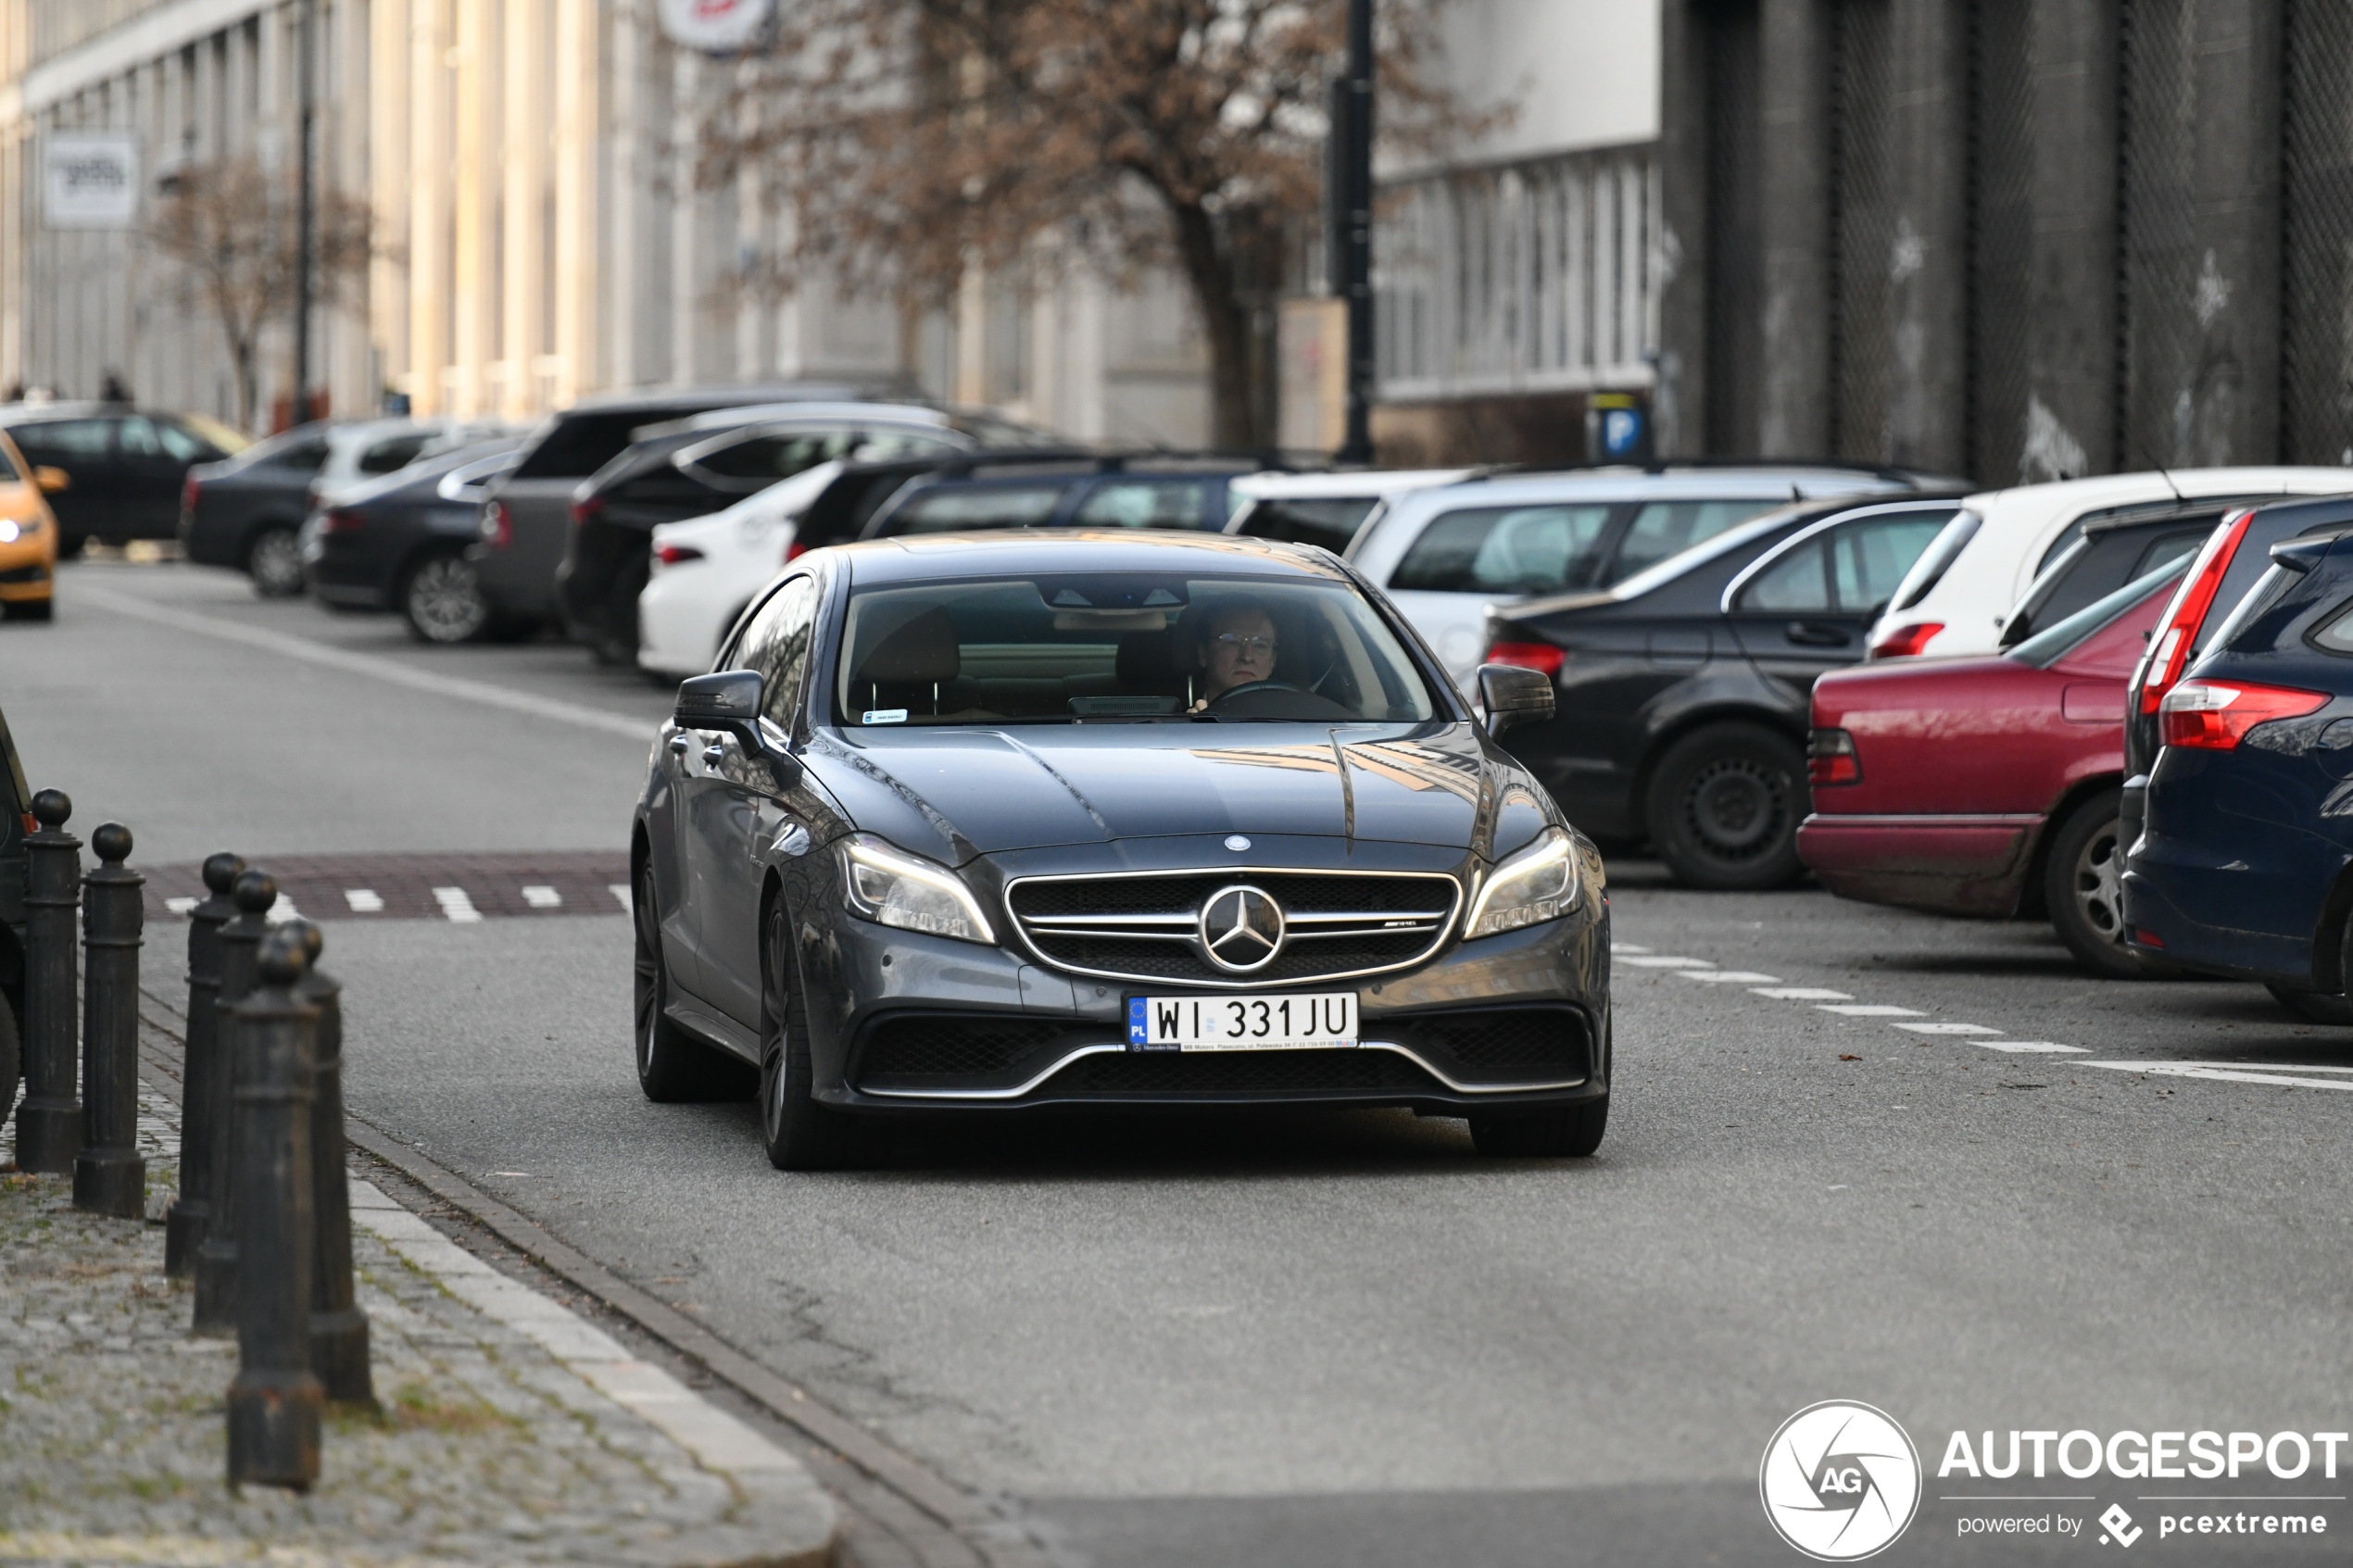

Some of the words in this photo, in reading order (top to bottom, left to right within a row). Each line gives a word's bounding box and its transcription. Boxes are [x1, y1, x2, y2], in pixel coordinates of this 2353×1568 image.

[1607, 410, 1634, 450] P
[1158, 1001, 1199, 1039] WI
[1227, 997, 1347, 1037] 331JU
[1131, 1026, 1146, 1036] PL
[1336, 1039, 1355, 1047] Mobil
